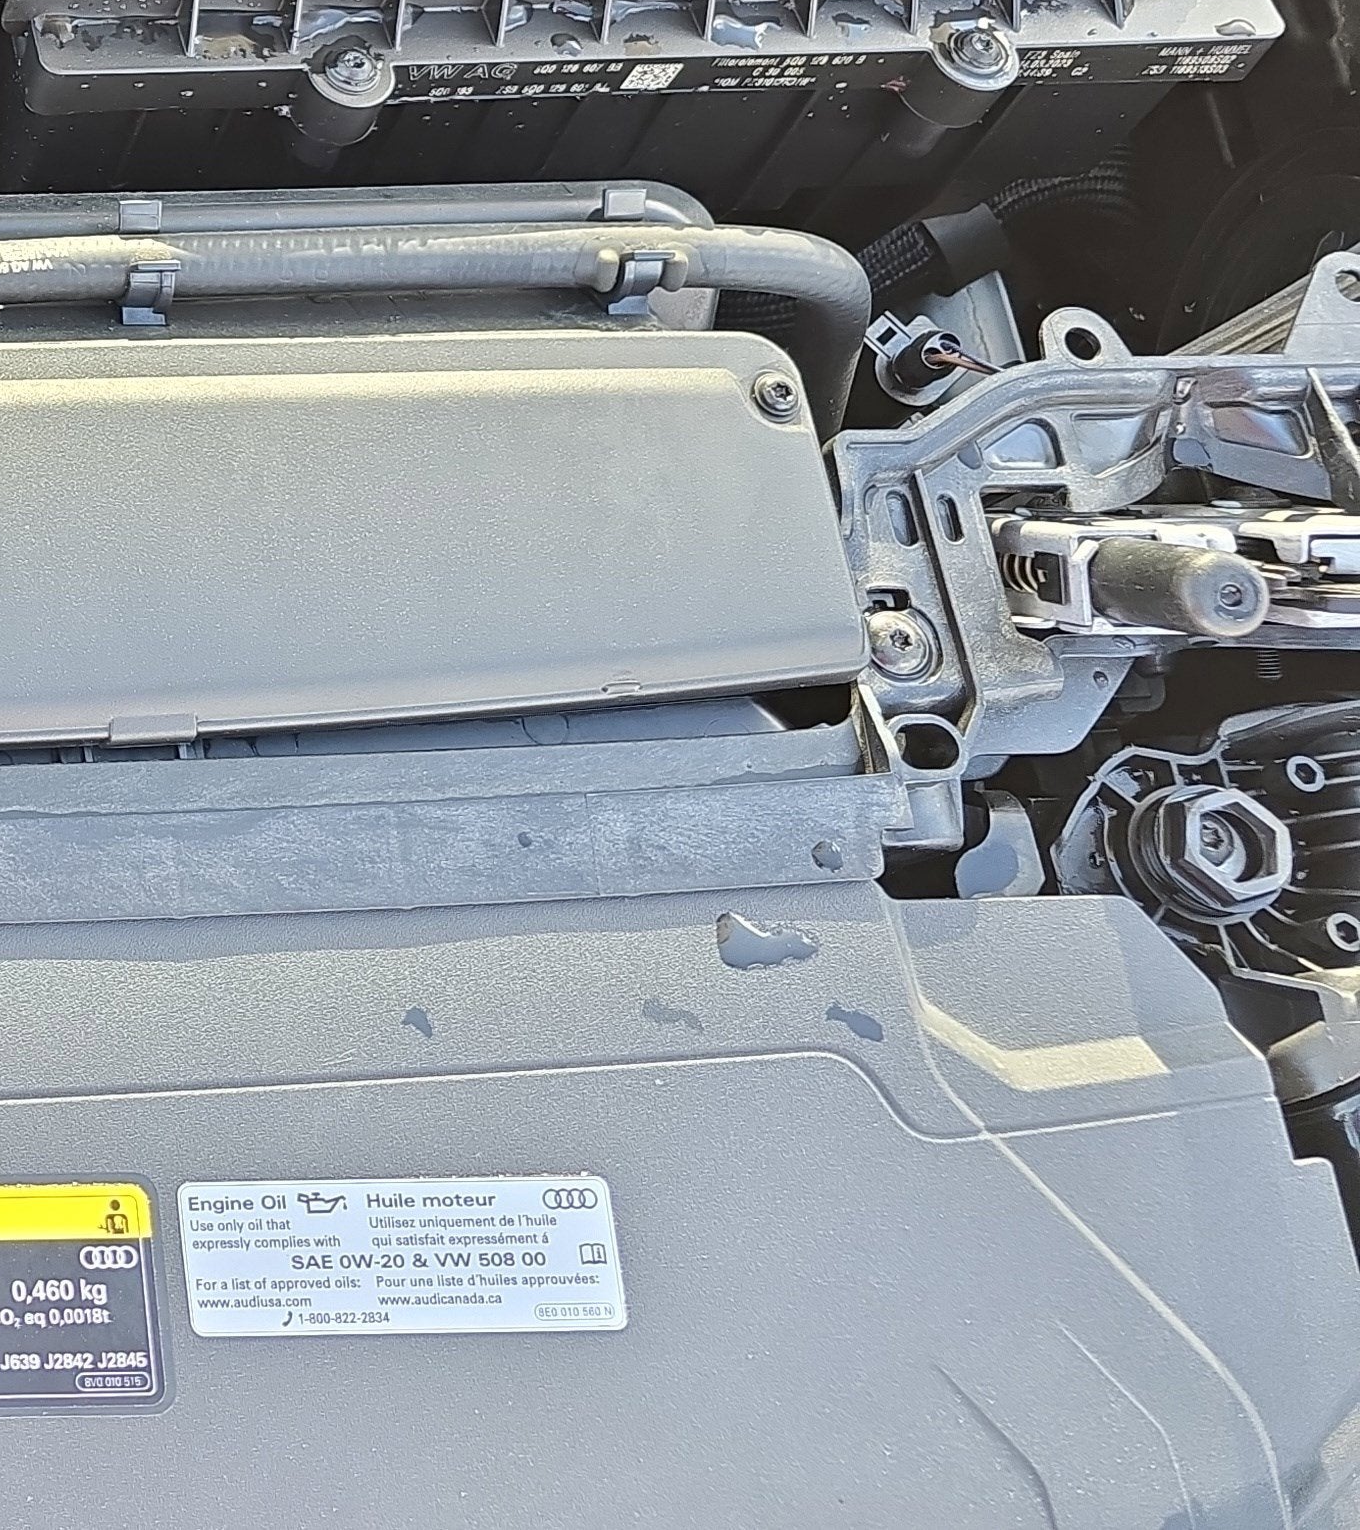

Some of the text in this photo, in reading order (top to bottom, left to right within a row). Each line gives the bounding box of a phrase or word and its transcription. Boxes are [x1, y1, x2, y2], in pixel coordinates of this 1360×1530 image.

[408, 63, 518, 81] VW AG
[188, 1195, 287, 1214] Engine Oil
[366, 1193, 496, 1208] Huile moteur
[190, 1219, 291, 1233] Use only oil that
[369, 1214, 557, 1230] Utilisez uniquement de l'huile
[192, 1235, 341, 1251] expressly complies with
[372, 1235, 392, 1248] qui
[396, 1234, 445, 1245] satisfait
[449, 1233, 538, 1247] expressément
[291, 1252, 546, 1270] SAE 0W-20 & VW 508 00
[196, 1276, 361, 1292] For a list of approved oils:
[376, 1273, 600, 1288] Pour une liste d'huiles approuvées:
[11, 1280, 75, 1304] 0,460
[79, 1278, 108, 1305] kg
[378, 1292, 502, 1306] www.audicanada.ca
[198, 1295, 312, 1308] www.audiusa.com
[24, 1312, 46, 1328] eq
[48, 1308, 112, 1327] 0,0018t
[299, 1312, 390, 1324] 1-800-822-2834
[560, 1307, 579, 1317] 010
[582, 1307, 601, 1316] 560
[604, 1307, 612, 1316] N
[0, 1354, 41, 1370] J639
[44, 1353, 94, 1370] J2842
[97, 1352, 148, 1368] J2845
